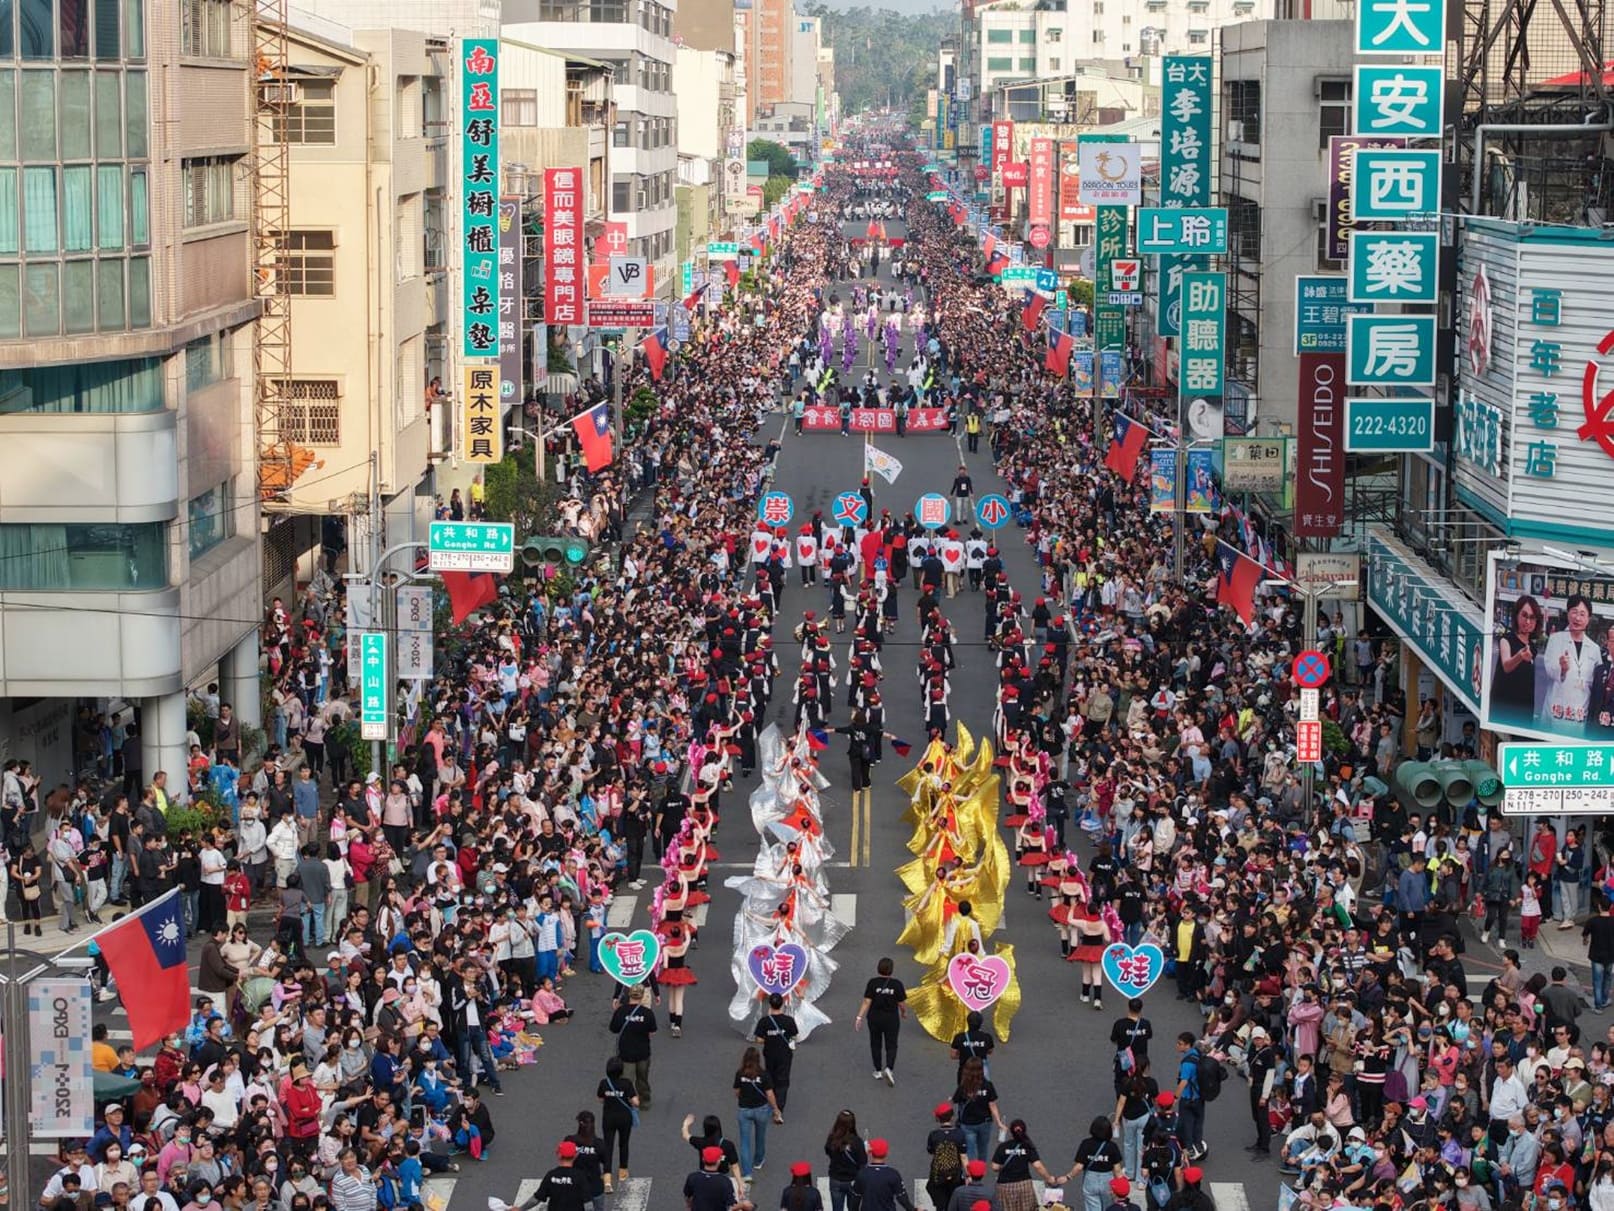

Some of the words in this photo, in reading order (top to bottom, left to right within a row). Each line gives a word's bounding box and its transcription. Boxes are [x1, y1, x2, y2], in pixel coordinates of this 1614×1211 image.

[1166, 62, 1206, 82] 台大
[1170, 88, 1202, 196] 李培源
[1082, 181, 1114, 190] DRAGON
[1116, 181, 1138, 190] TOURS
[1364, 0, 1430, 377] 大安西藥房
[1100, 209, 1124, 259] 診所
[1144, 215, 1211, 243] 上聆
[553, 171, 575, 321] 信而美眼鏡專門店
[1186, 280, 1219, 389] 助聽器
[1302, 334, 1317, 345] 3F
[1525, 287, 1563, 478] 百年老店
[469, 370, 493, 458] 原木家具
[1309, 364, 1334, 502] SHISEIDO
[765, 497, 789, 522] 崇
[834, 496, 864, 522] 文
[982, 499, 1007, 524] 小
[1303, 514, 1336, 527] 資生堂
[443, 526, 498, 540] 共和路
[444, 541, 478, 549] Gonghe
[367, 656, 380, 708] 中山路
[1522, 750, 1604, 767] 共和路
[1525, 771, 1573, 784] Gonghe
[1582, 771, 1602, 781] Rd.
[1566, 790, 1608, 800] 250-242
[615, 939, 645, 978] 靈
[762, 951, 794, 988] 精
[1118, 954, 1152, 988] 桂
